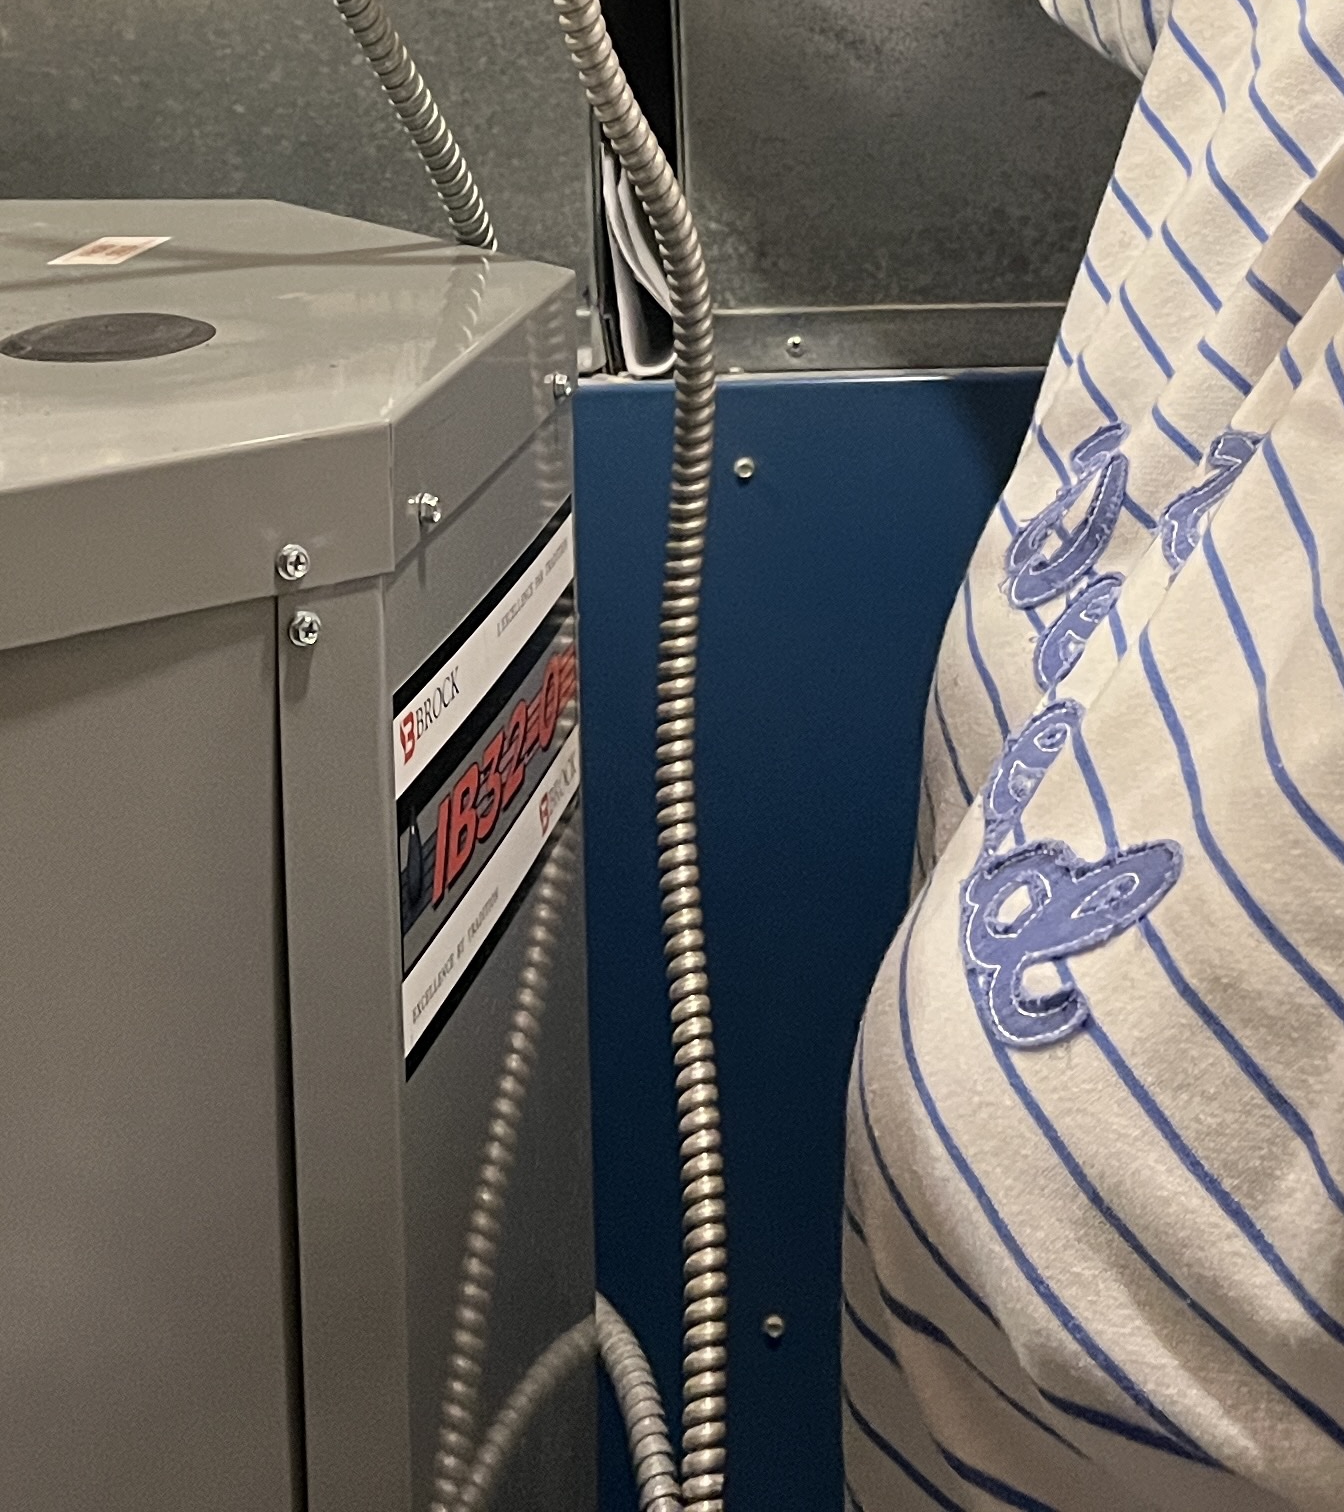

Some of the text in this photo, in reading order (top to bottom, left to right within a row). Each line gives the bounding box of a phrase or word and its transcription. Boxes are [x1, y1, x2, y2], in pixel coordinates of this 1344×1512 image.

[415, 666, 460, 741] BROCK
[412, 953, 454, 1024] EXCELLENCE
[467, 887, 499, 940] TRADITION
